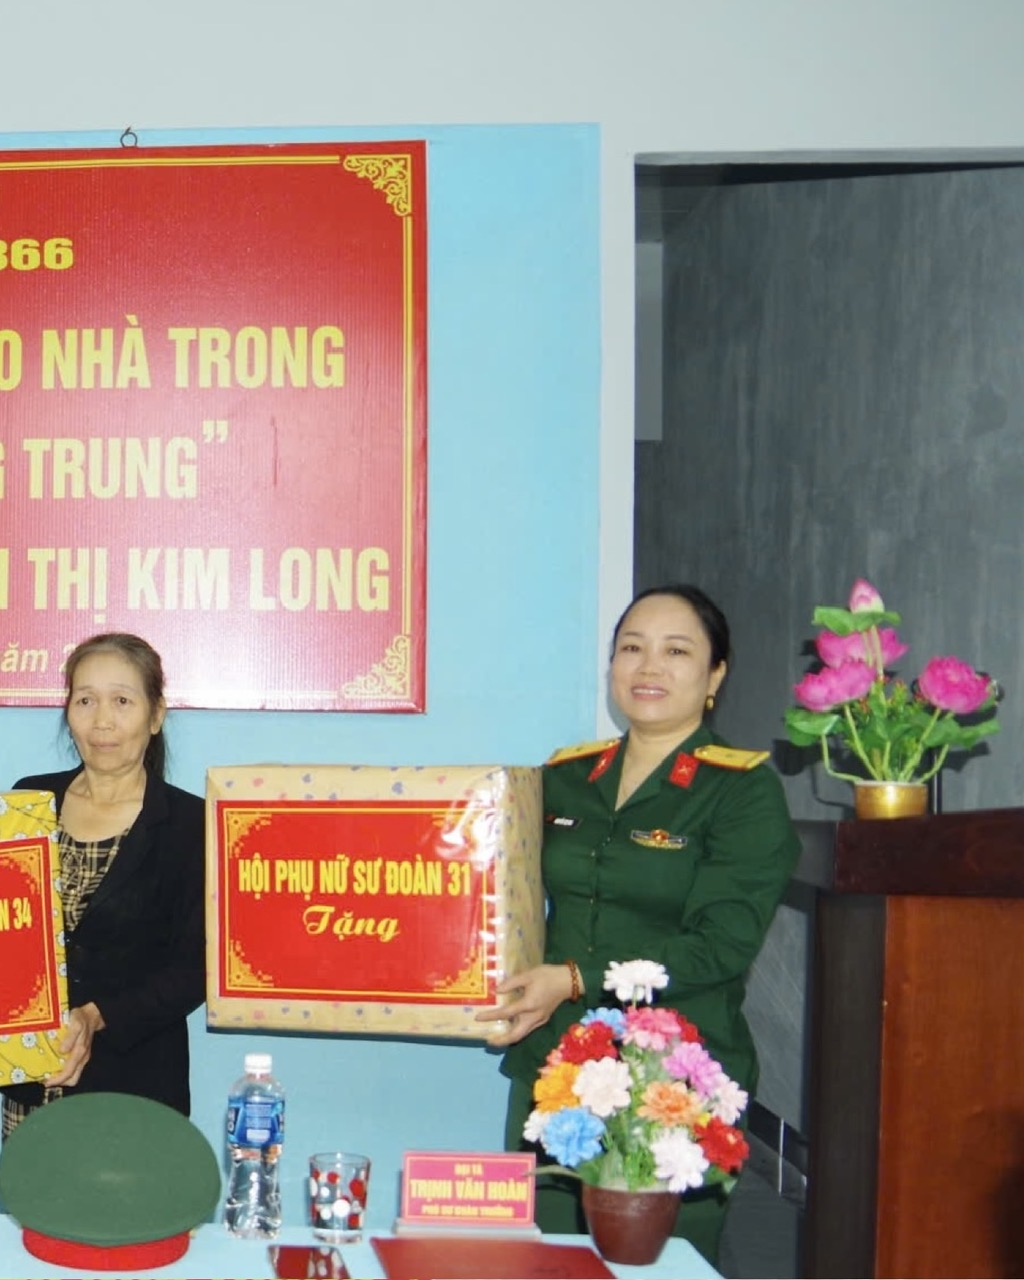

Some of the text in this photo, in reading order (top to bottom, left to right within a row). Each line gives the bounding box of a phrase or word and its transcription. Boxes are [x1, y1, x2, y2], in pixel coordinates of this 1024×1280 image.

[42, 314, 151, 389] NHÀ
[169, 326, 345, 389] TRONG
[28, 547, 108, 624] THỊ
[128, 547, 231, 611] KIM
[250, 546, 390, 612] LONG
[238, 852, 471, 901] HỘI PHỤ NỮ SƯ ĐOÀN 31
[12, 896, 32, 929] 34
[302, 904, 400, 943] Tặng
